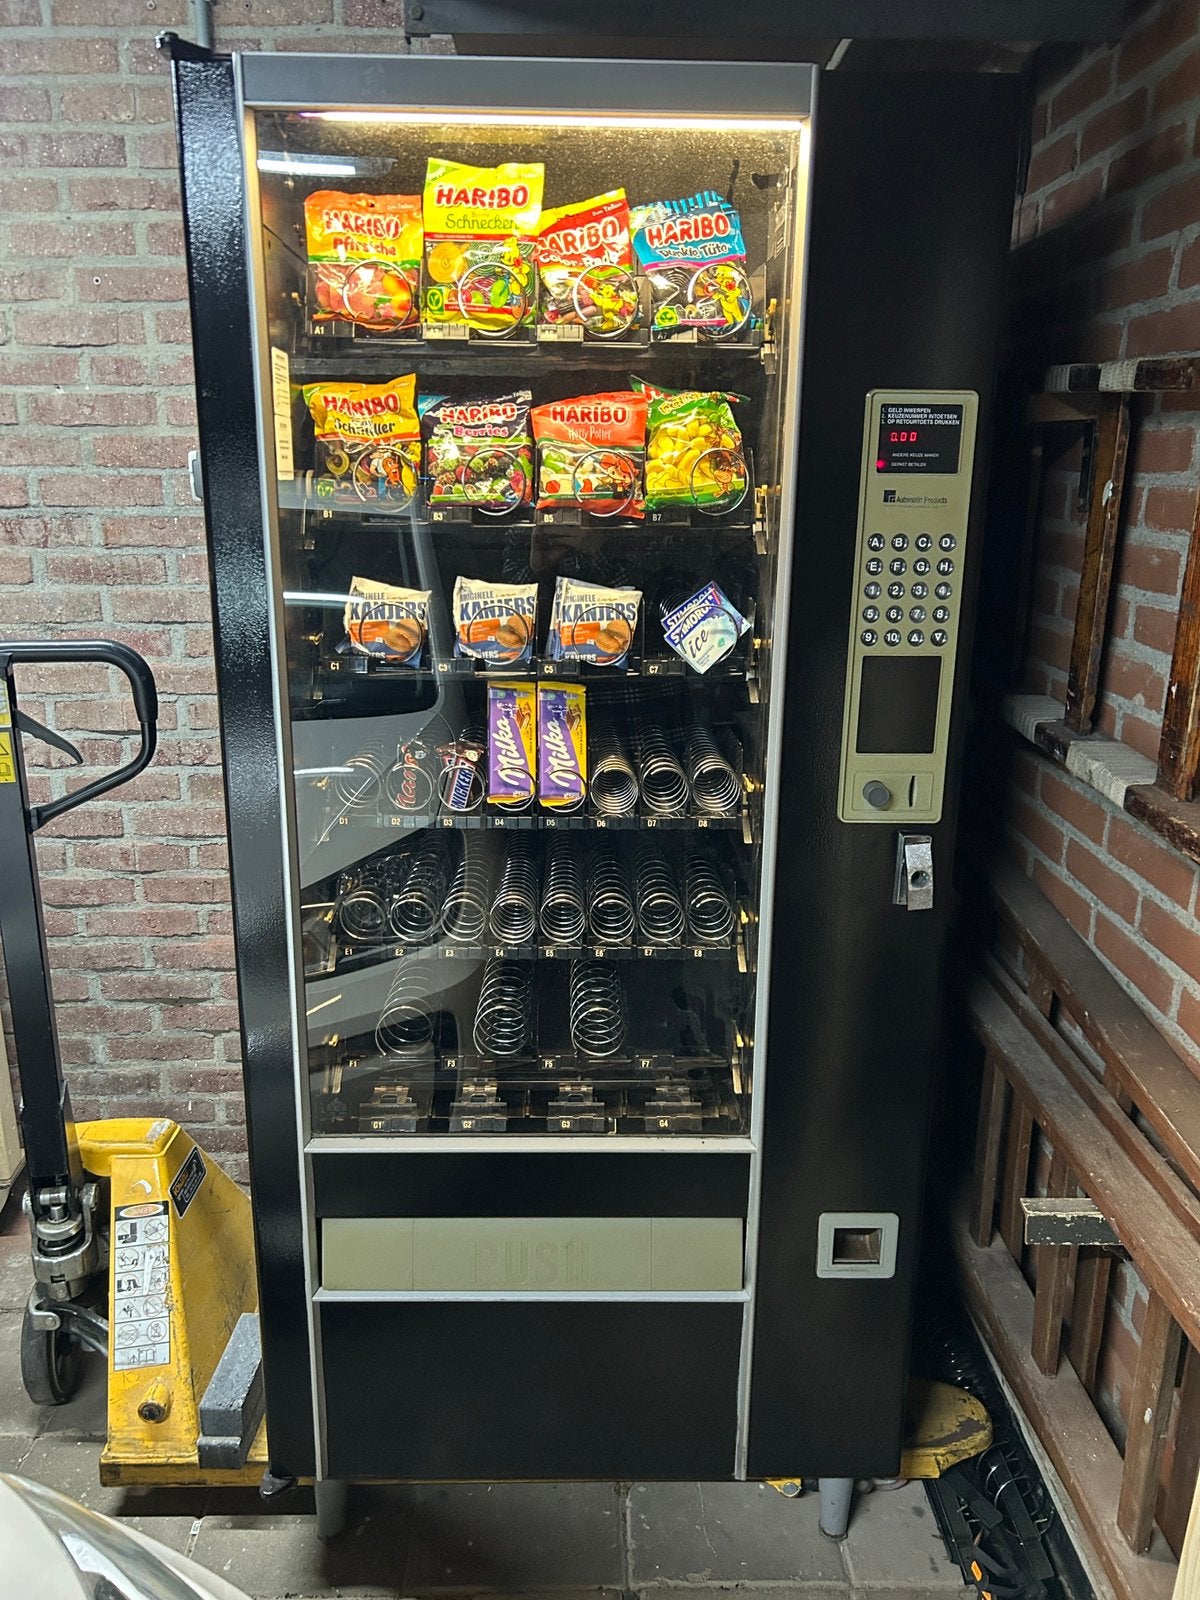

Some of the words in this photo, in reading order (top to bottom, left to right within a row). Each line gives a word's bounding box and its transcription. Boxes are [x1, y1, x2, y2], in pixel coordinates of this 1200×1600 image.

[435, 182, 529, 209] HARIBO
[323, 209, 402, 240] HARIBO
[445, 213, 520, 231] Schnecken
[645, 212, 731, 249] HARIBO
[658, 245, 700, 260] Dunkle
[314, 325, 325, 335] A1
[322, 392, 402, 417] HARIBO
[439, 402, 518, 424] HARIBO
[550, 405, 630, 426] HARIBO
[452, 423, 510, 438] Berries
[589, 427, 612, 441] Potter
[923, 496, 948, 504] Products
[323, 510, 333, 519] B1
[433, 512, 443, 521] B3
[543, 514, 554, 523] B5
[652, 513, 662, 522] B7
[871, 538, 880, 547] A
[895, 537, 903, 547] B
[918, 537, 927, 547] C
[942, 538, 950, 547] D
[870, 562, 877, 571] E
[893, 562, 901, 571] F
[917, 562, 925, 571] G
[940, 562, 948, 571] H
[871, 586, 875, 595] 1
[892, 586, 899, 595] 2
[915, 586, 922, 595] 3
[939, 586, 946, 595] 4
[350, 601, 427, 621] KANJERS
[460, 595, 536, 620] KANJERS
[562, 602, 636, 623] KANJERS
[867, 609, 874, 618] 5
[890, 609, 897, 618] 6
[914, 610, 920, 618] 7
[936, 609, 944, 618] 8
[865, 633, 872, 641] 9
[887, 633, 897, 641] 10
[688, 629, 709, 659] ice
[330, 662, 340, 670] C1
[438, 663, 448, 672] C3
[544, 665, 554, 674] C5
[649, 665, 659, 674] C7
[492, 714, 526, 786] Milka
[542, 717, 577, 788] Milka
[450, 759, 475, 809] NICKERS
[339, 817, 348, 825] D1
[391, 818, 401, 826] D2
[443, 819, 453, 827] D3
[495, 818, 504, 826] D4
[546, 818, 556, 827] D5
[545, 949, 554, 957] E5
[595, 949, 603, 957] E6
[641, 1060, 649, 1068] F7
[373, 1121, 382, 1129] G1
[562, 1120, 570, 1128] G3
[473, 1240, 591, 1284] PUSH
